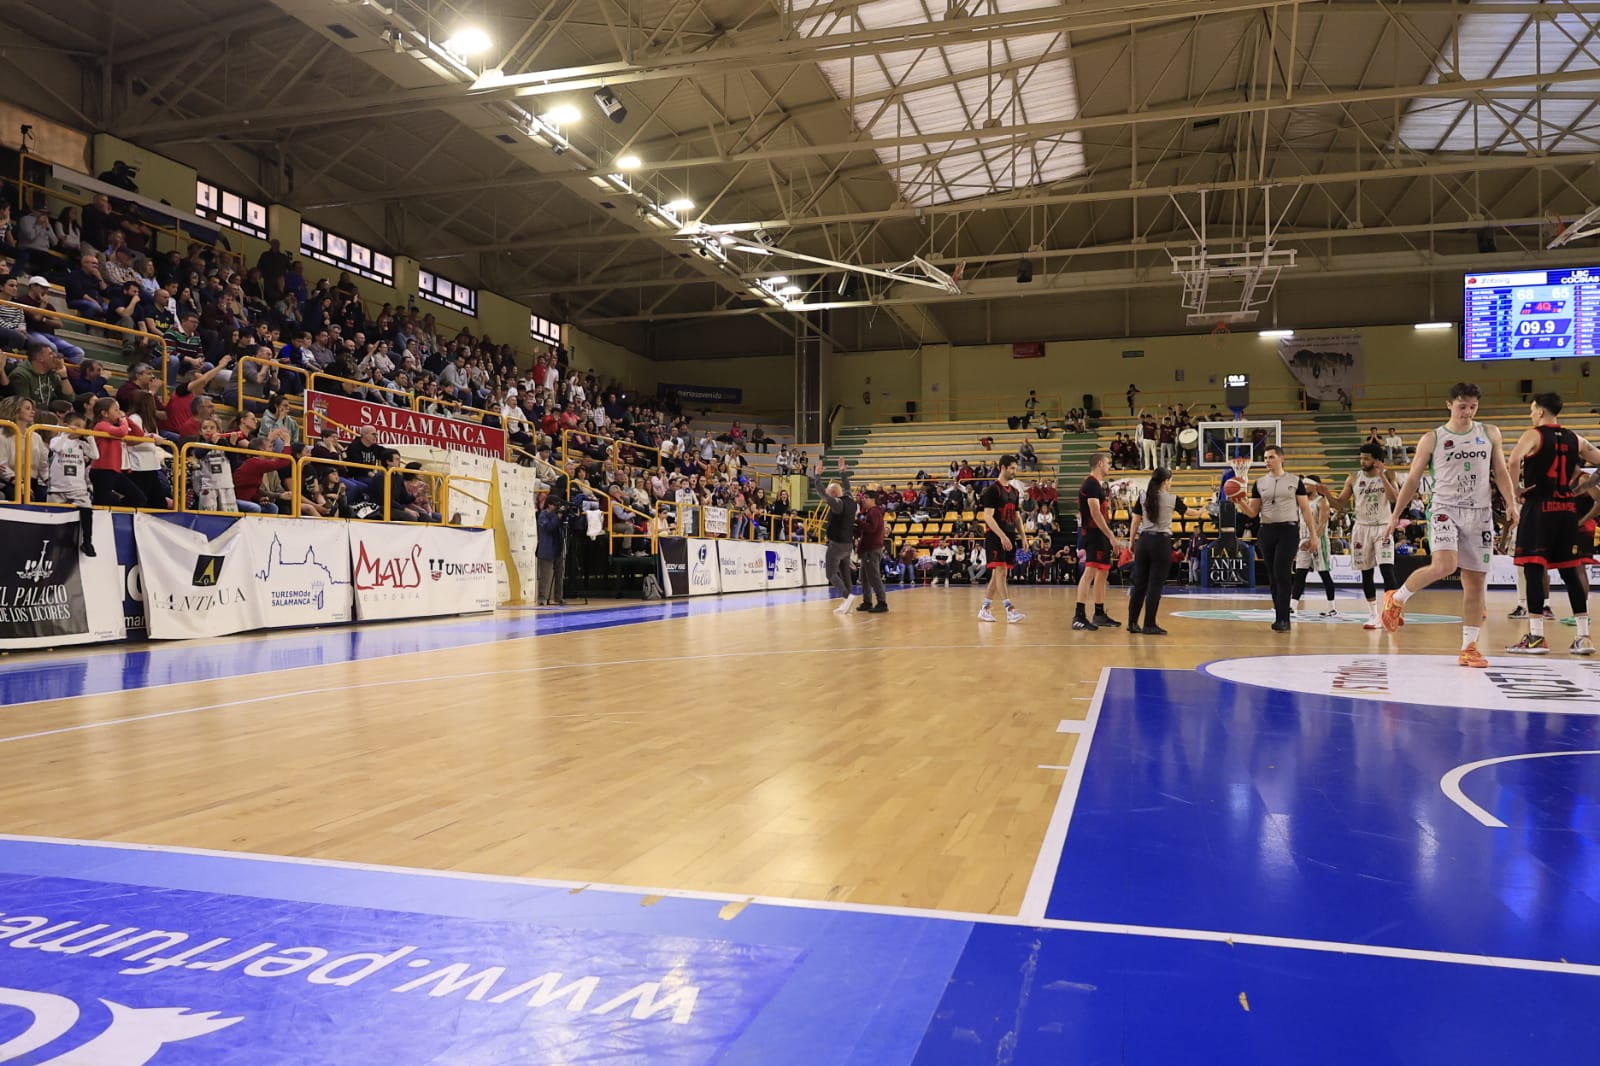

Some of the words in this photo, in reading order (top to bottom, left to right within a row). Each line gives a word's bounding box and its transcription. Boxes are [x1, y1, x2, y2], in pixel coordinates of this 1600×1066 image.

[1520, 320, 1555, 335] 09.9
[360, 405, 487, 445] SALAMANCA
[336, 424, 410, 445] PATONIO
[1463, 461, 1471, 472] 9
[1547, 455, 1568, 487] 41
[1211, 547, 1230, 559] LA
[355, 540, 422, 590] MAYS
[445, 561, 494, 576] UNICARNE
[1210, 570, 1239, 582] GUA
[0, 586, 8, 606] L
[13, 584, 68, 606] PALACIO
[271, 598, 311, 607] SALAMANCA
[10, 607, 28, 622] LOS
[29, 604, 71, 622] LICORES
[0, 912, 700, 1025] www.perfume
